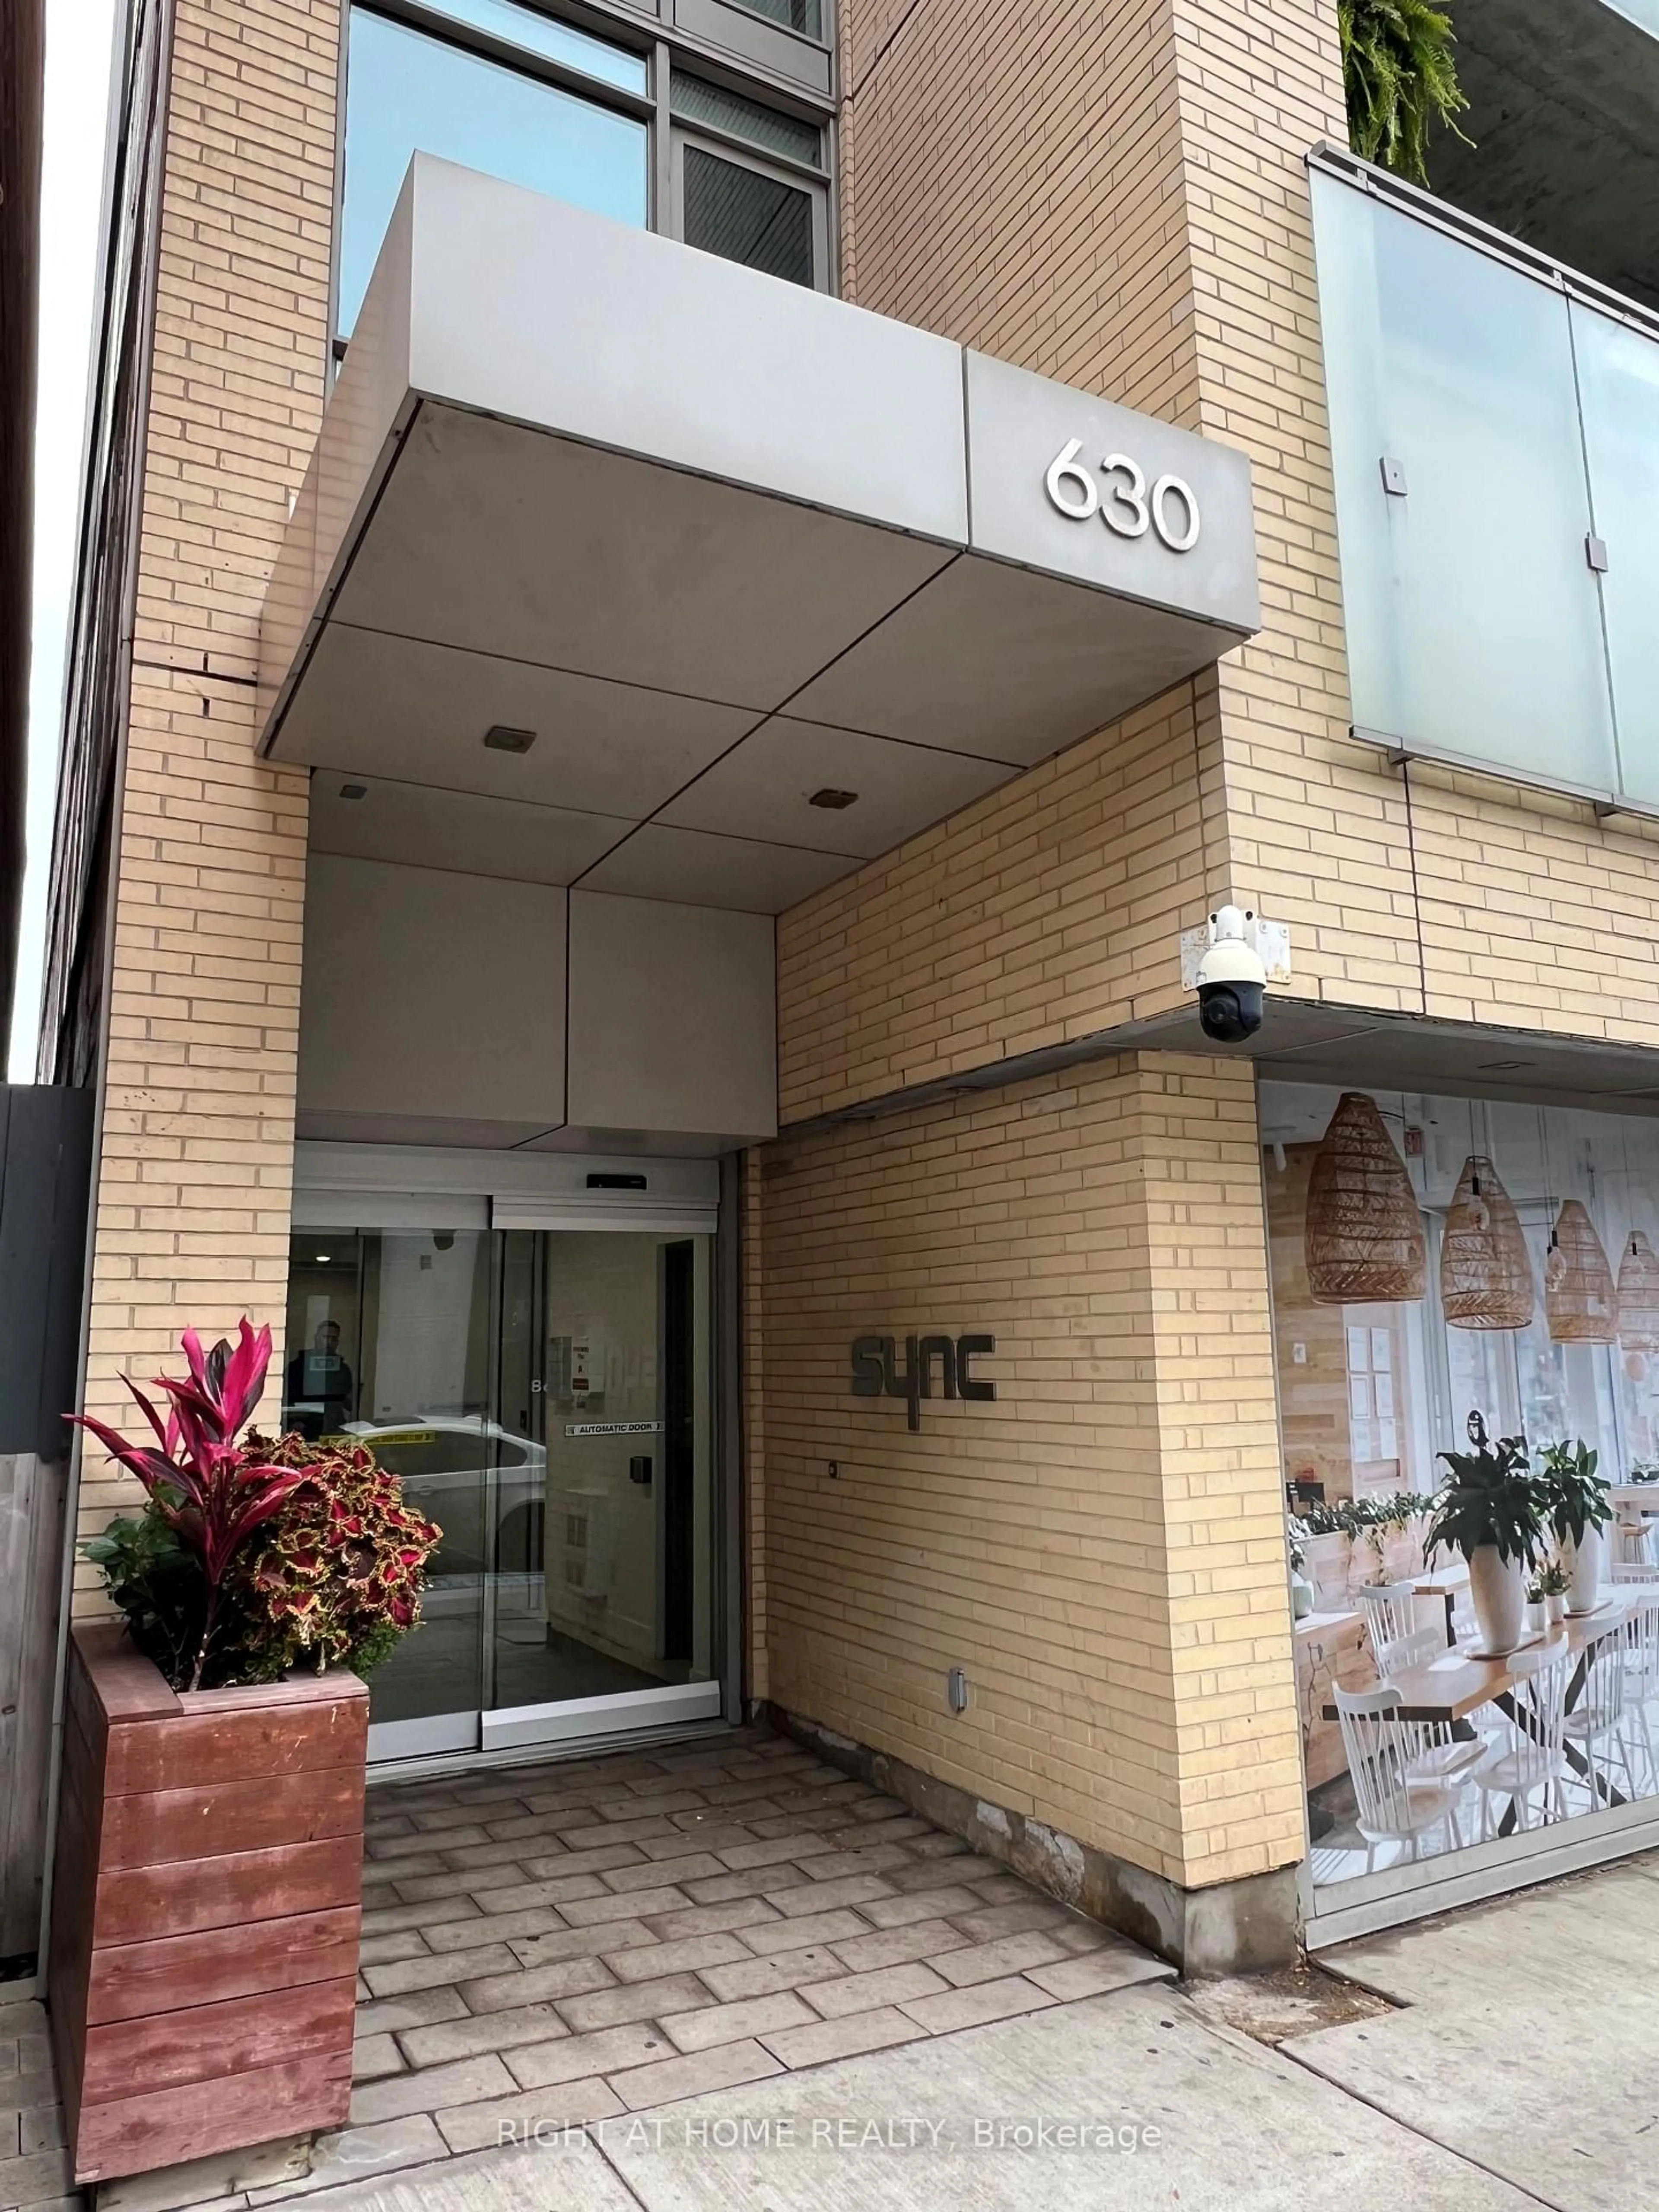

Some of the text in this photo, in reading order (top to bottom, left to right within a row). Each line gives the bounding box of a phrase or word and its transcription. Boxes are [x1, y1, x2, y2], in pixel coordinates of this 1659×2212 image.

[1044, 437, 1200, 552] 630
[579, 1424, 626, 1433] AUTOMATIC
[852, 1334, 996, 1431] sync
